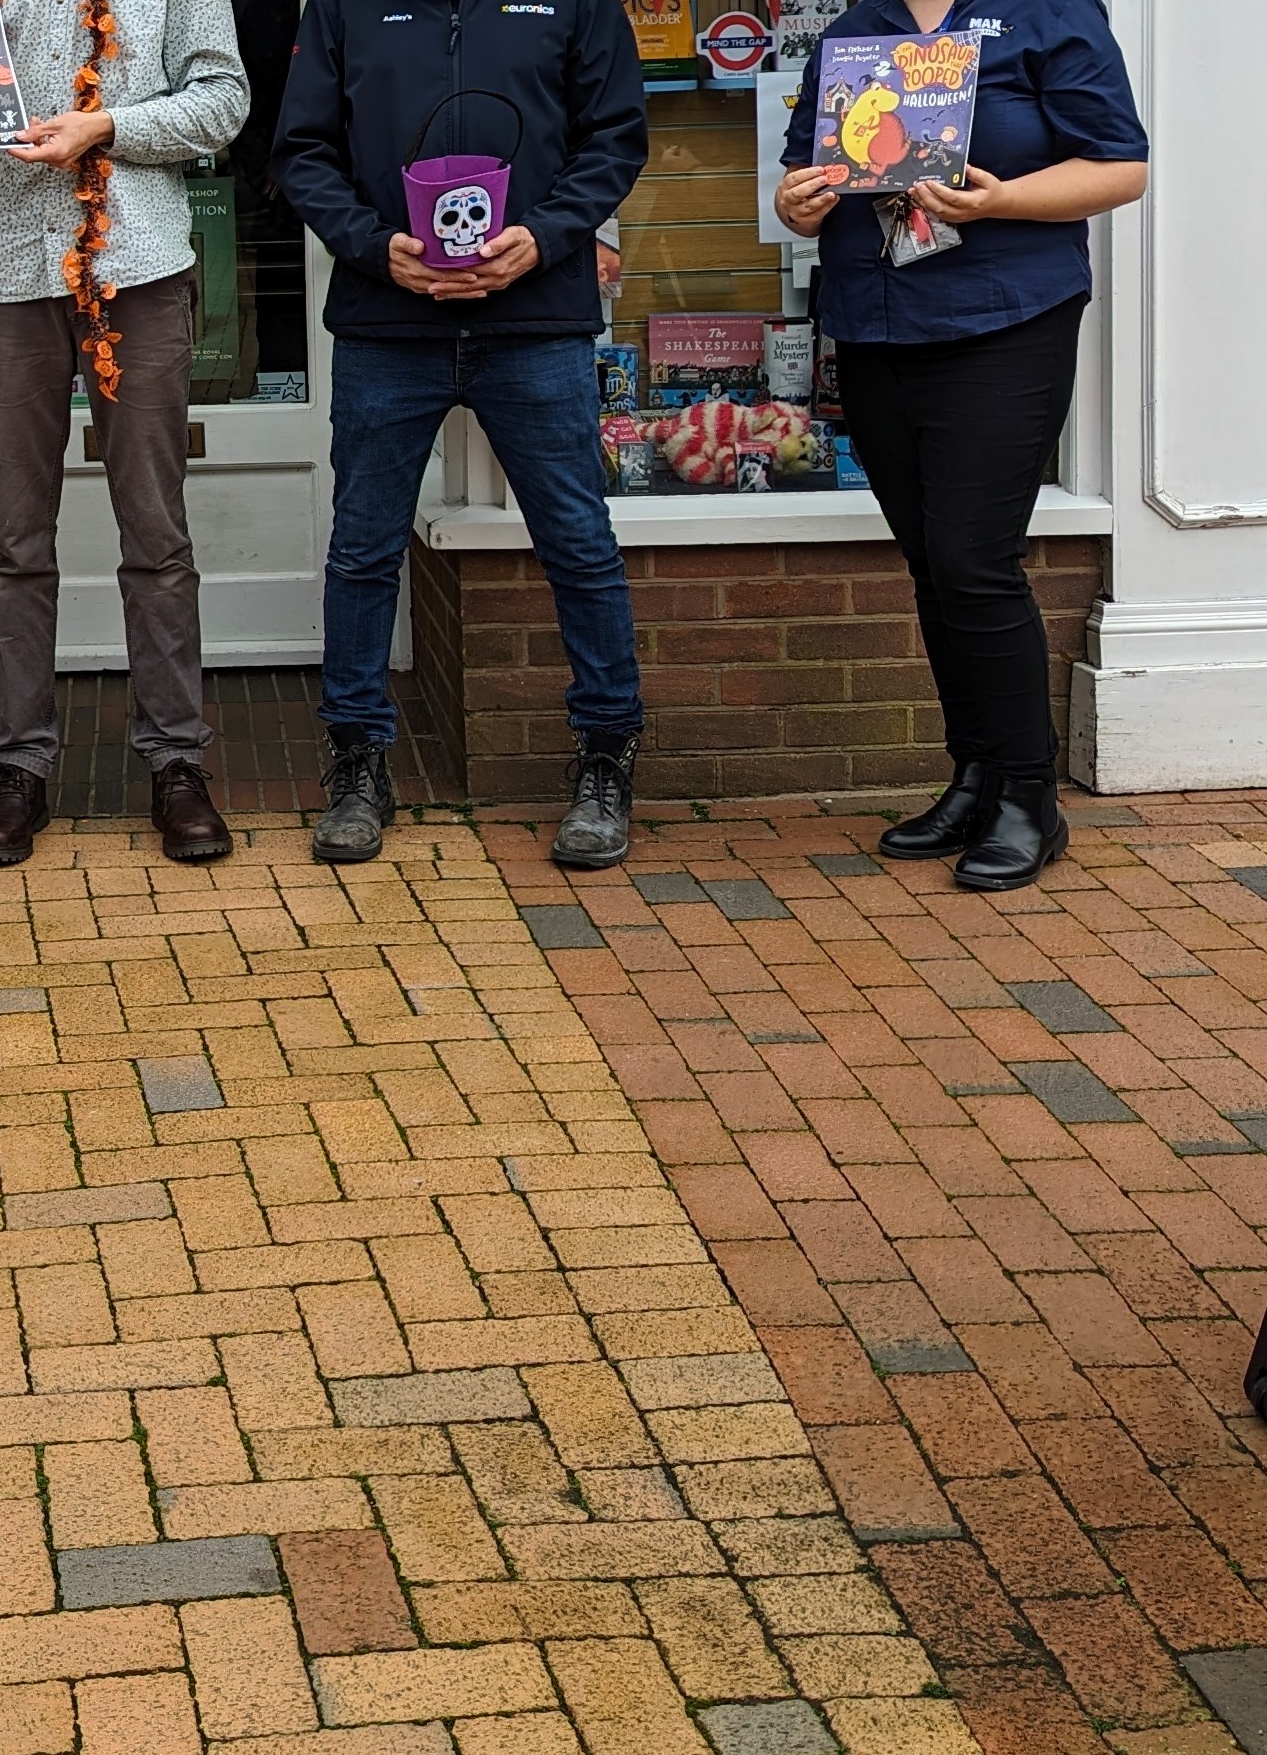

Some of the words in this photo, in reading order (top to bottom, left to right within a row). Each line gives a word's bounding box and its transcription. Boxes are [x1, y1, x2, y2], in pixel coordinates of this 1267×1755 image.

[507, 3, 555, 16] euronics
[968, 17, 1003, 32] MAX
[706, 39, 730, 48] MIND
[730, 38, 748, 47] THE
[748, 37, 767, 46] GAP
[897, 42, 974, 70] DINOSAUR
[903, 67, 960, 88] POOPED
[902, 84, 974, 109] HALLOWEEN!
[708, 327, 727, 339] The
[775, 340, 809, 351] Murder
[704, 353, 731, 363] Game
[773, 350, 810, 362] Mystery
